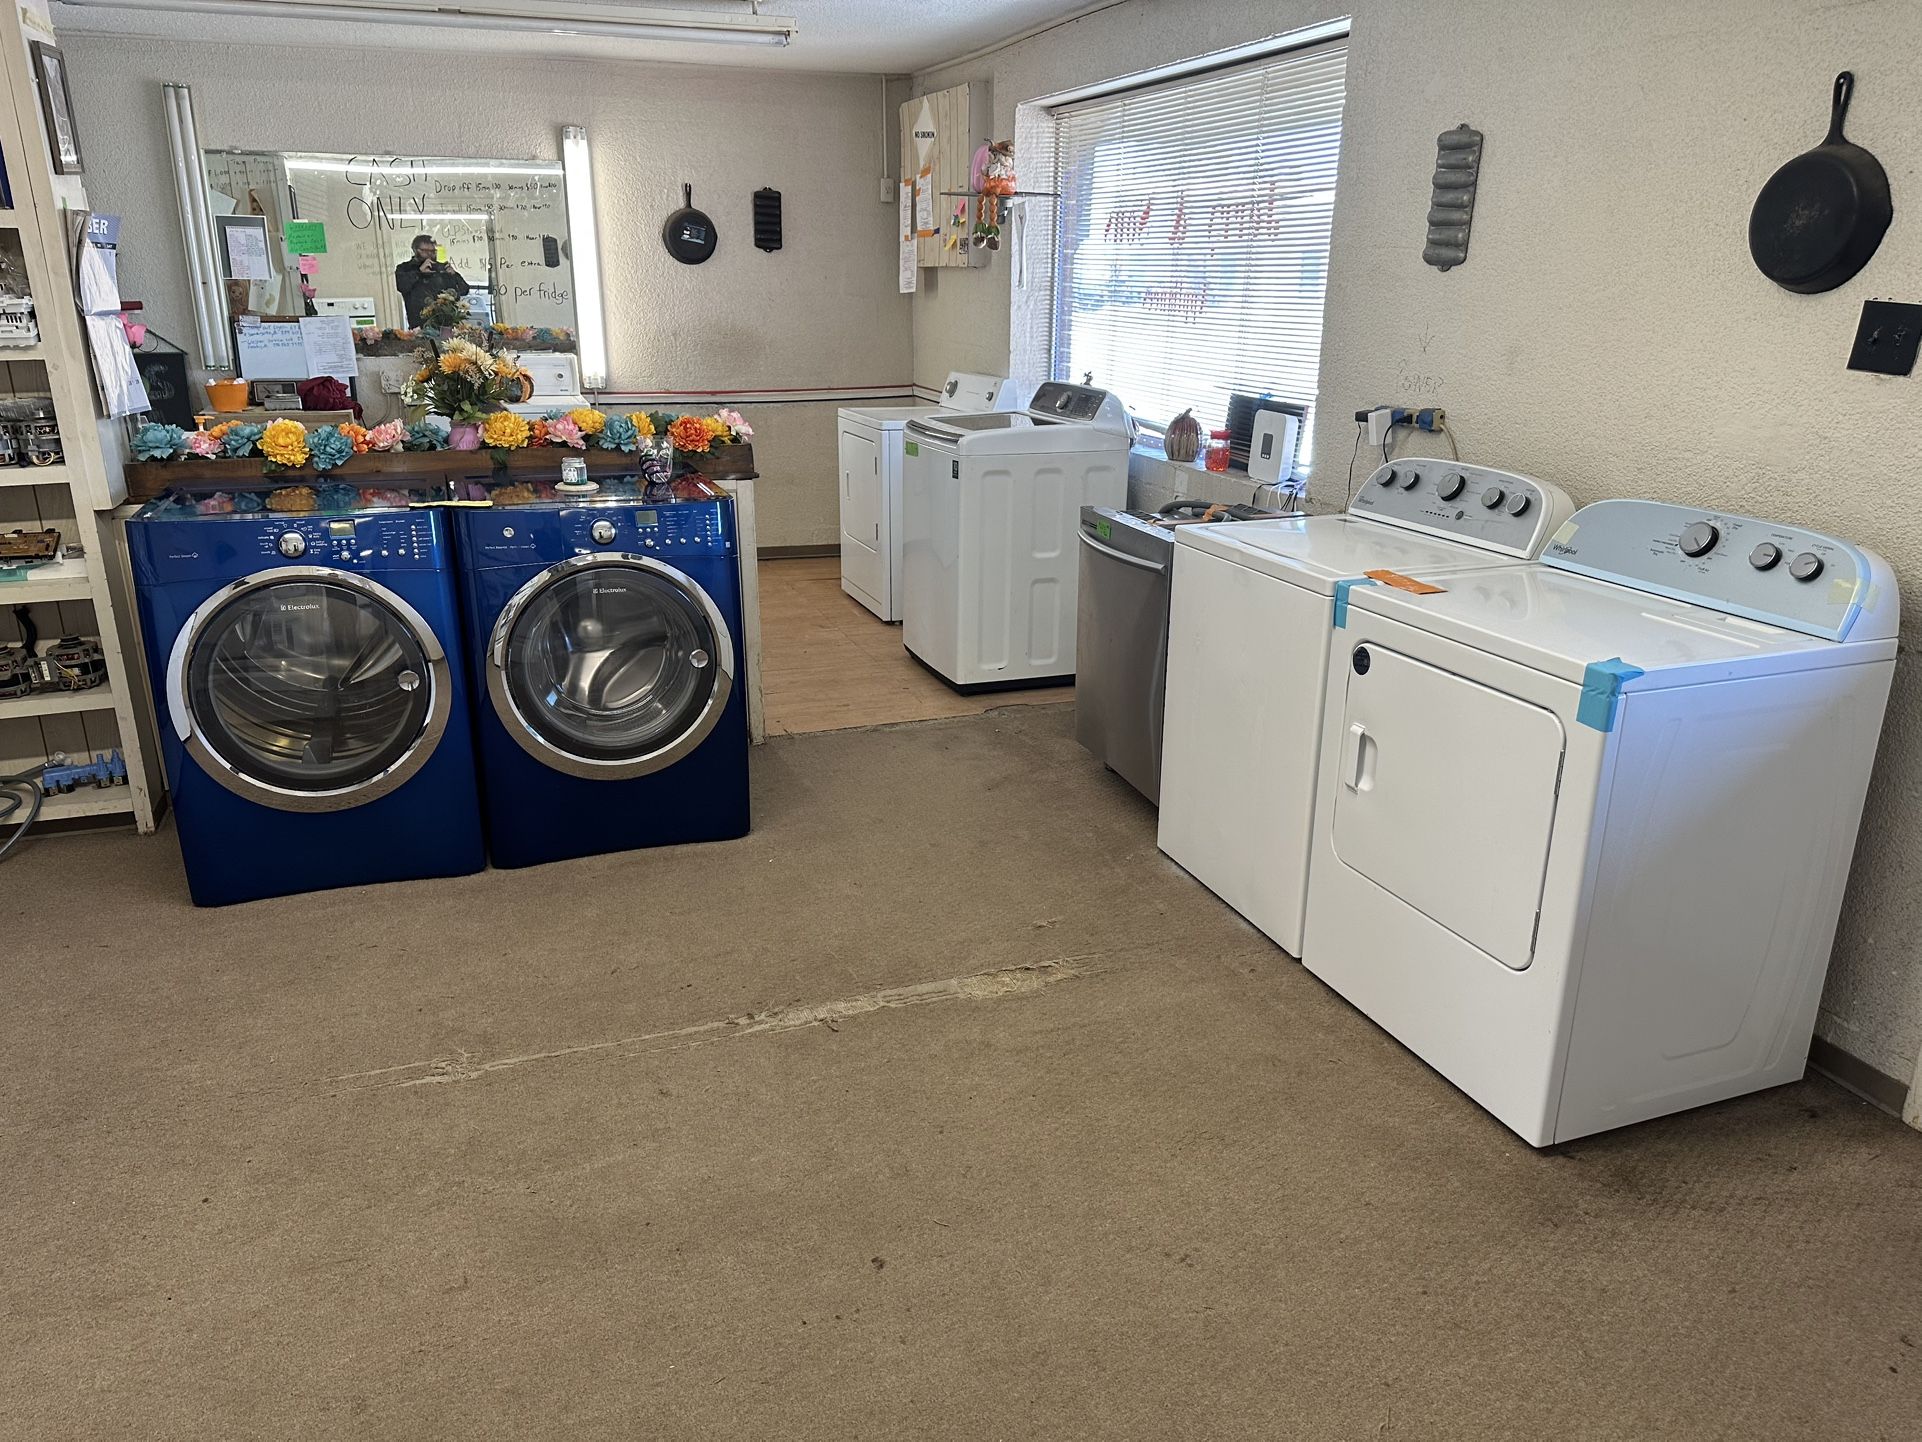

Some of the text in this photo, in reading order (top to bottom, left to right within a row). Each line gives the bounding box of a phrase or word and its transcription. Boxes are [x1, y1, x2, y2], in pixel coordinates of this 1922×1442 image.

[914, 130, 920, 139] NO
[345, 155, 428, 188] CASH
[434, 180, 456, 193] Drop
[346, 193, 426, 231] ONLY
[449, 256, 472, 270] Add
[500, 256, 514, 269] Per
[514, 285, 533, 305] per
[537, 281, 569, 305] fridge
[1552, 544, 1578, 556] Whirlpool
